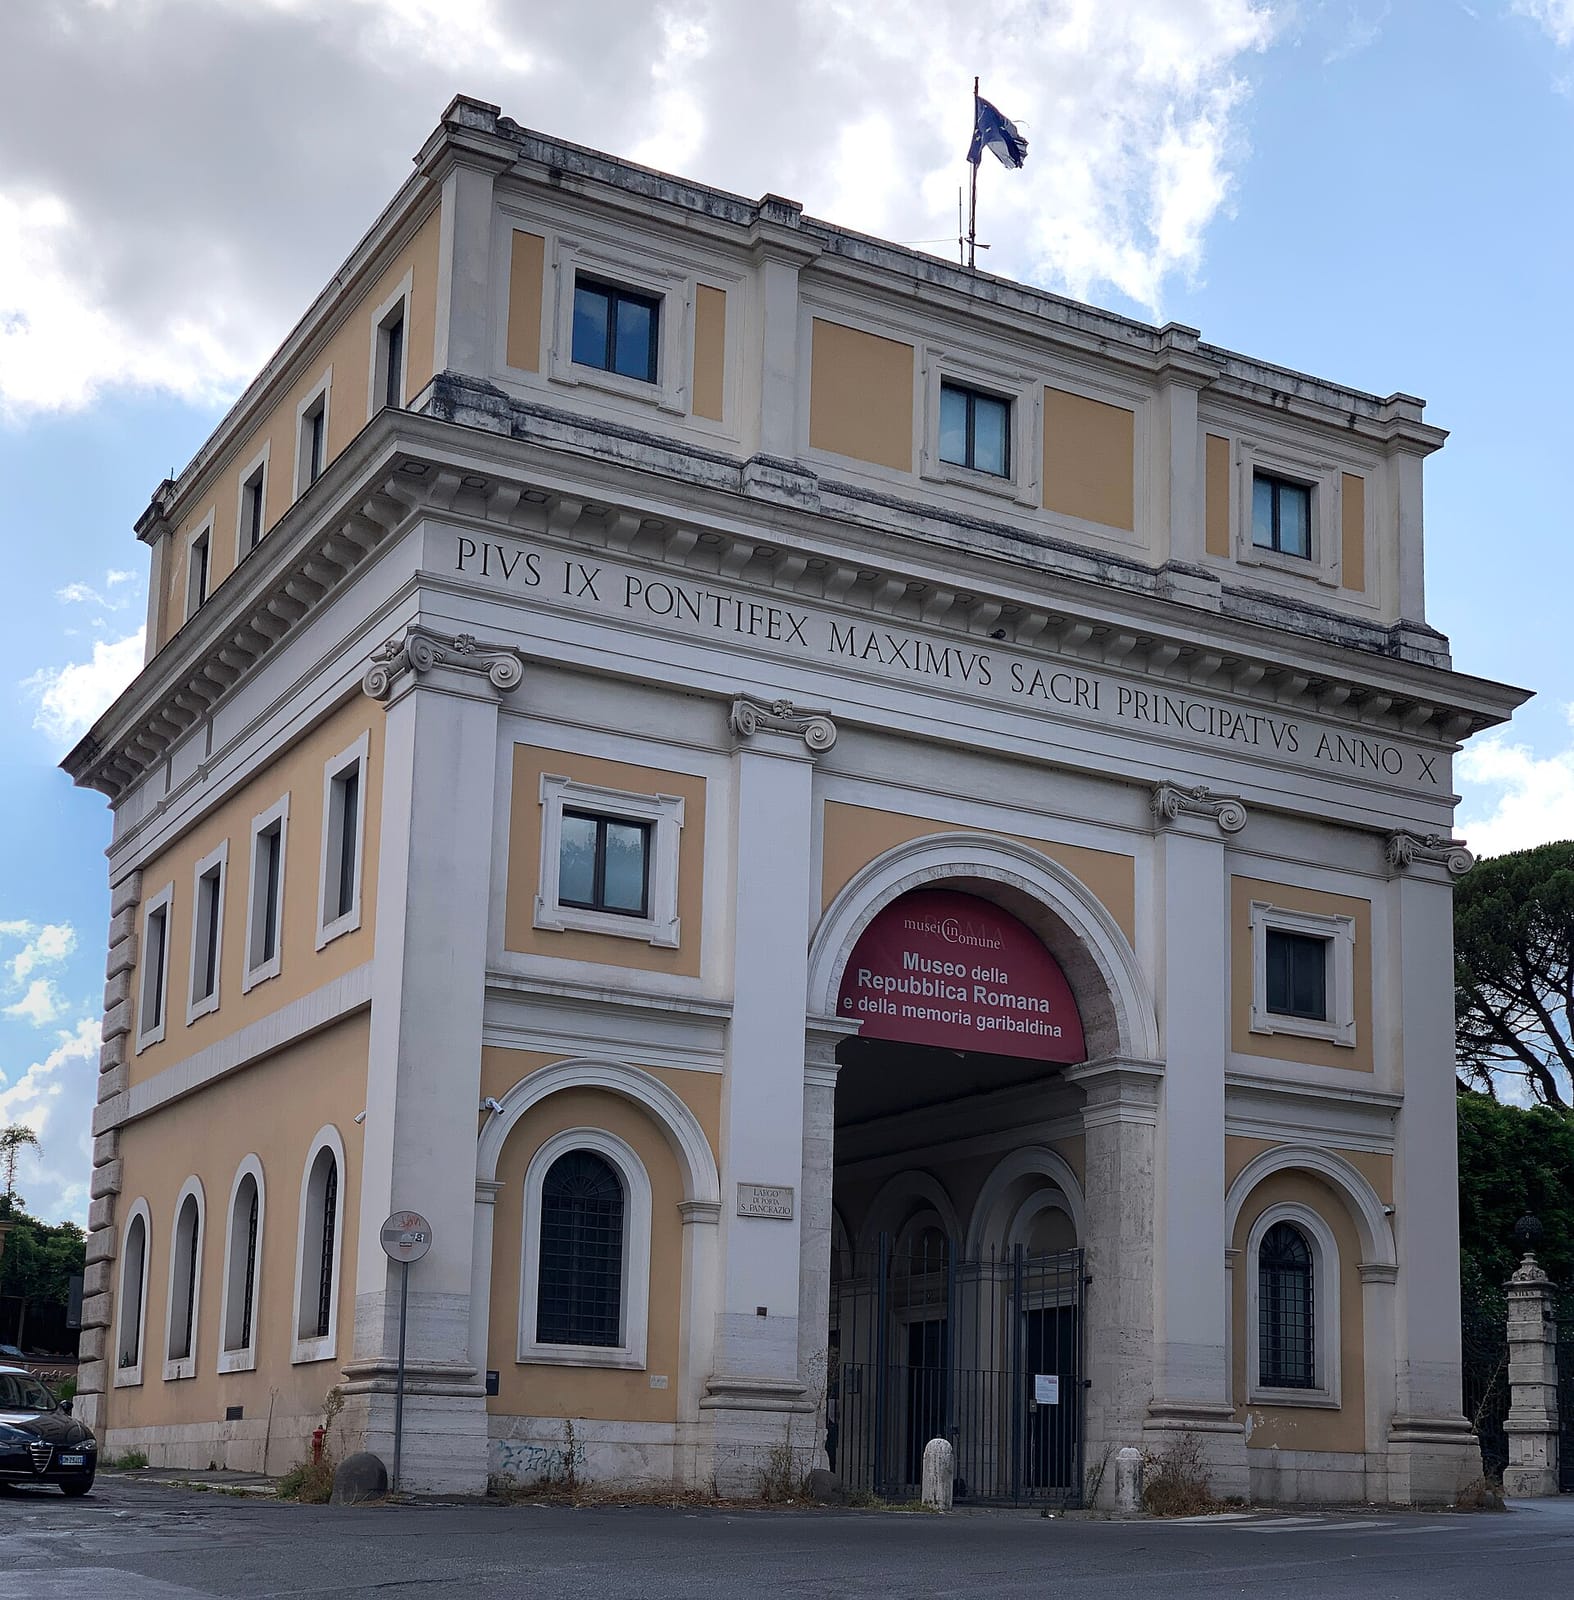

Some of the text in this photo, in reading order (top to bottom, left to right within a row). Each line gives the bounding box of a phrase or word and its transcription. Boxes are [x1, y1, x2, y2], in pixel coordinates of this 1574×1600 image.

[455, 536, 1437, 784] PIVS IX PONTIFEX MAXIMVS SACRI PRINCIPATVS ANNO X
[903, 951, 1008, 984] Museo della
[858, 968, 1050, 1013] Repubblica Romana
[843, 996, 1062, 1038] e della memoria garibaldina
[749, 1204, 791, 1214] PANCRAZIO
[753, 1188, 779, 1197] LARGO
